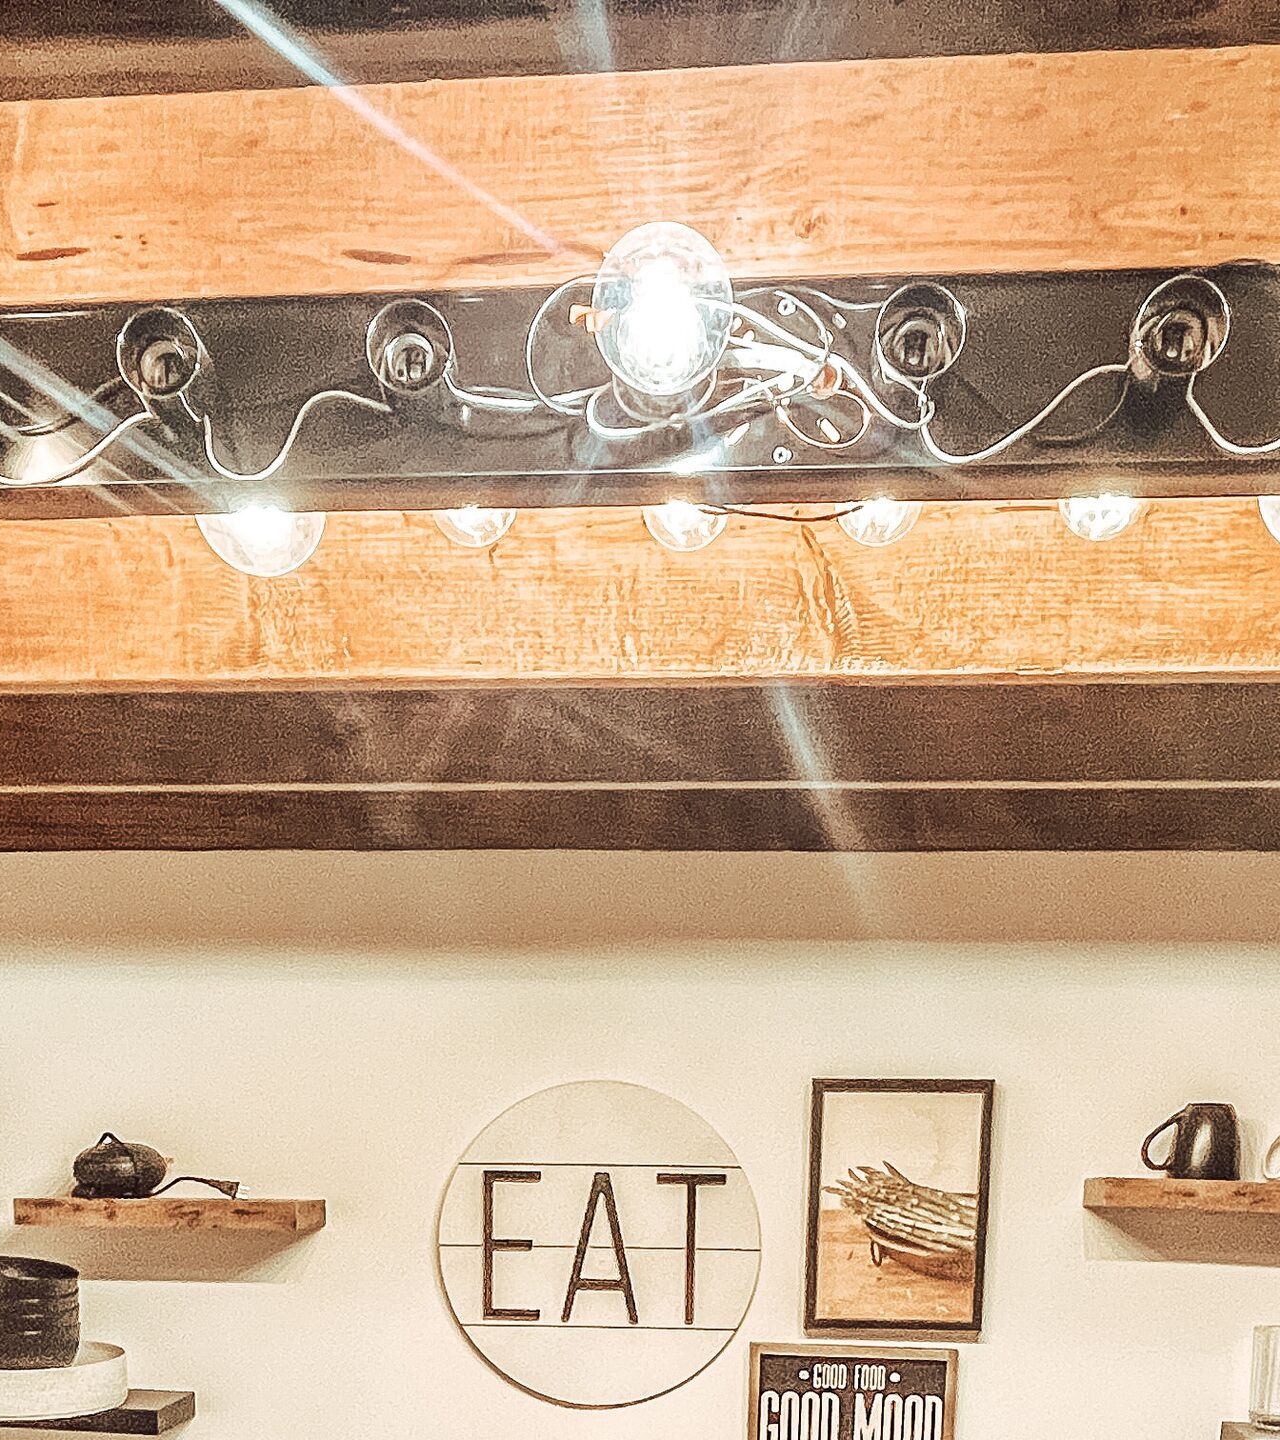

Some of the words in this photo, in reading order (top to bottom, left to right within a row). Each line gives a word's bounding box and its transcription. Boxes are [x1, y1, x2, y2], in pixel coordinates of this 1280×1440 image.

[482, 1170, 727, 1325] EAT
[812, 1363, 848, 1390] GOOD
[854, 1364, 886, 1391] FOOD
